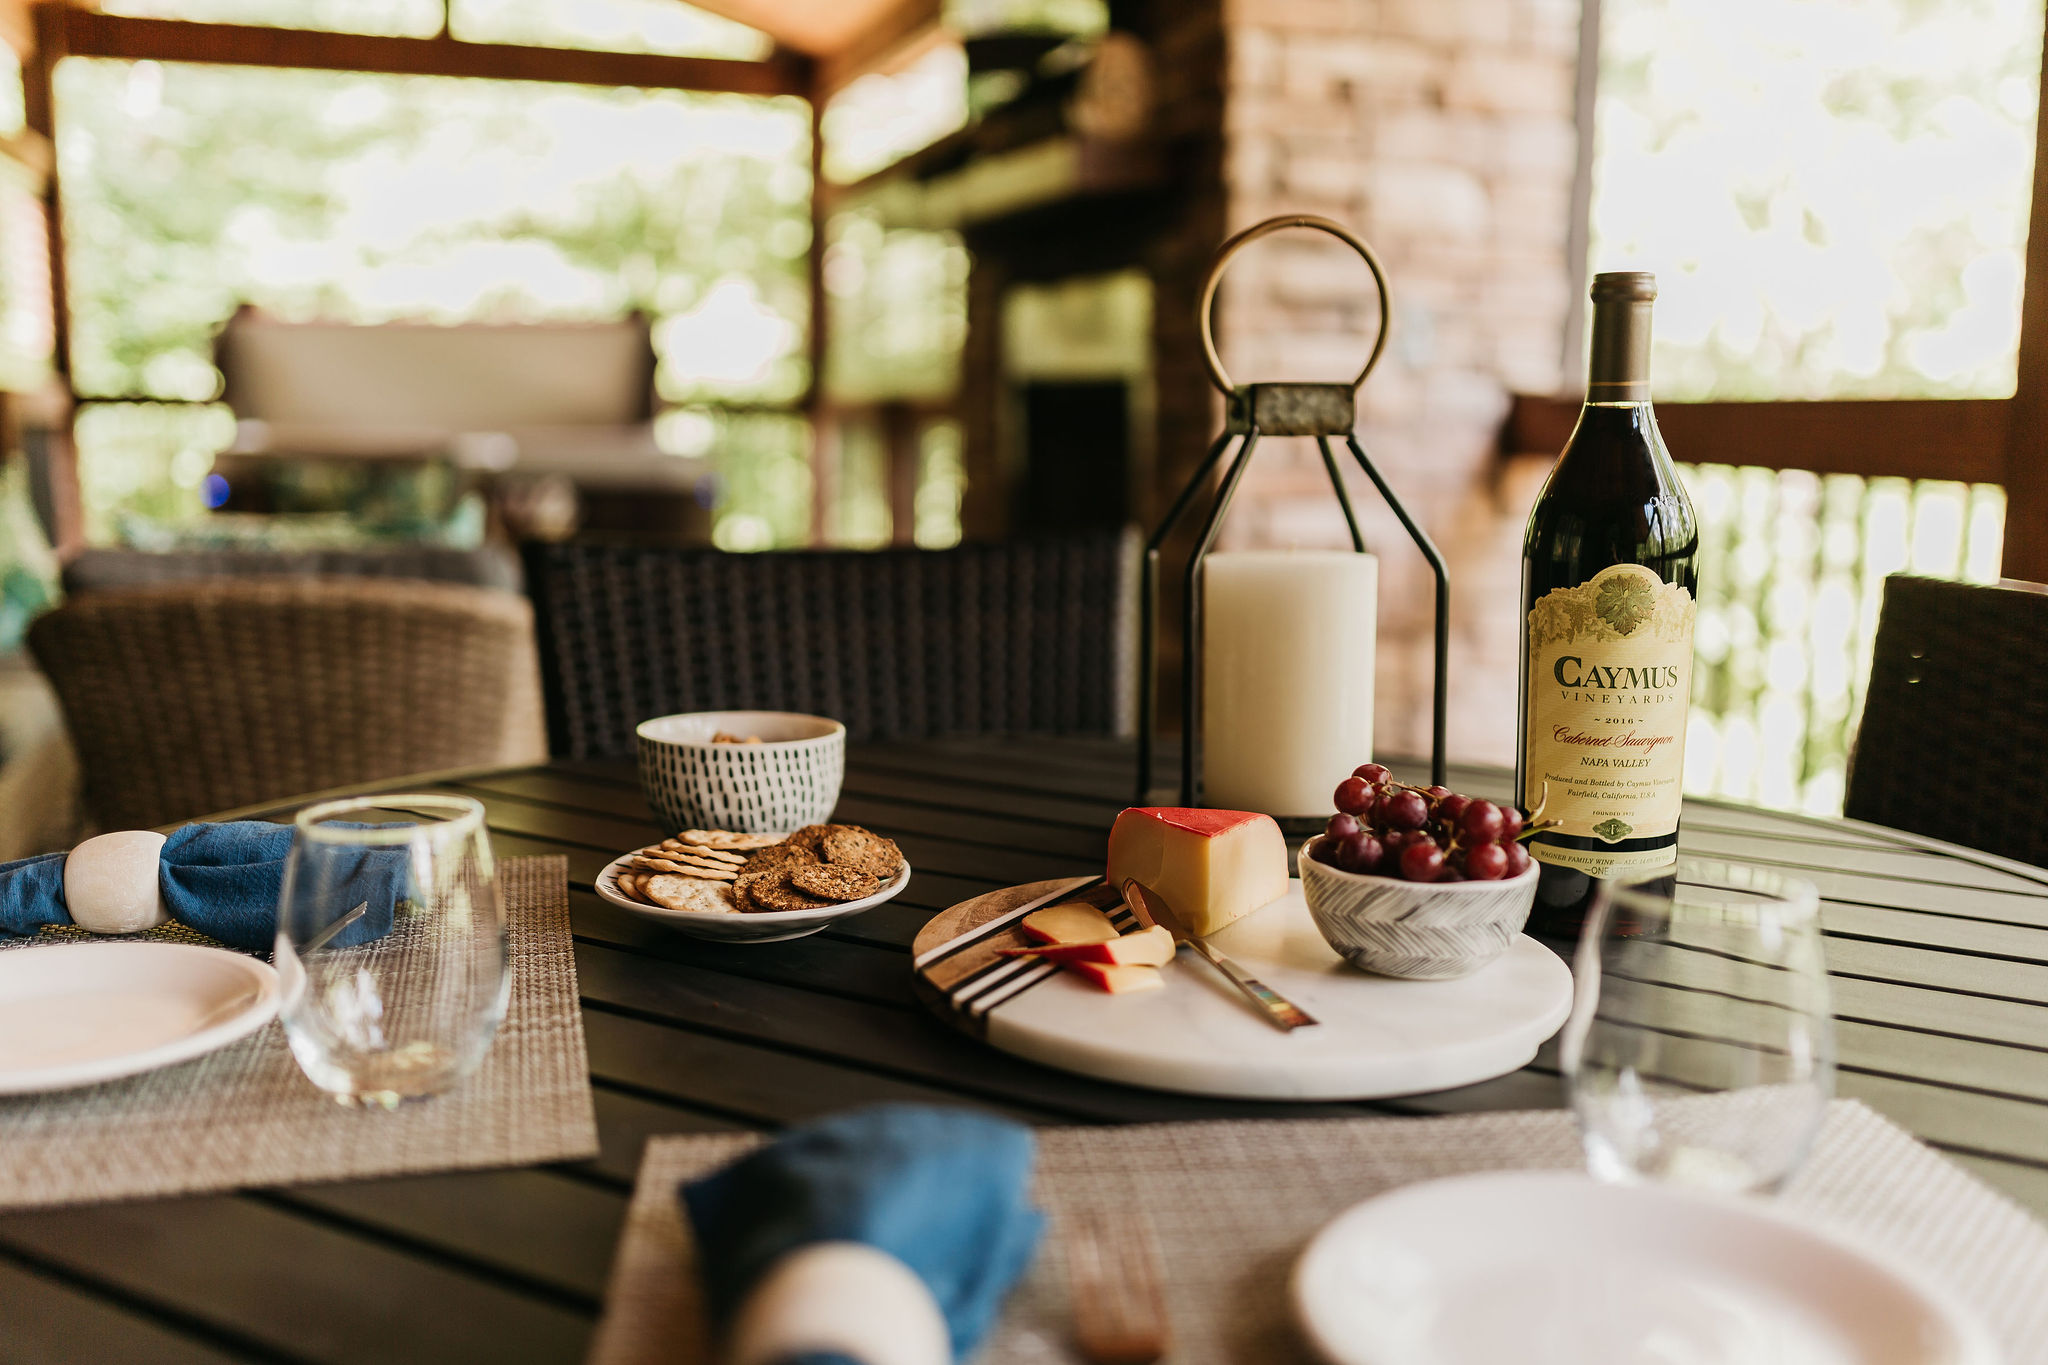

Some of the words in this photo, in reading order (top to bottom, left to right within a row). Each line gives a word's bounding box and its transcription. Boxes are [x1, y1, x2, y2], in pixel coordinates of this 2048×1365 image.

[1562, 690, 1674, 704] VINEYARDS
[1552, 724, 1612, 747] Cabernet
[1614, 730, 1673, 755] Sauvignon
[1580, 757, 1609, 768] NAPA
[1612, 758, 1652, 768] VALLEY
[1545, 772, 1573, 783] Produced
[1590, 778, 1615, 788] Bottled
[1617, 780, 1625, 788] by
[1567, 788, 1600, 800] Fairfield,
[1601, 791, 1639, 801] California,
[1540, 850, 1567, 862] WAGNER
[1568, 855, 1594, 865] FAMILY
[1595, 857, 1615, 866] WINE
